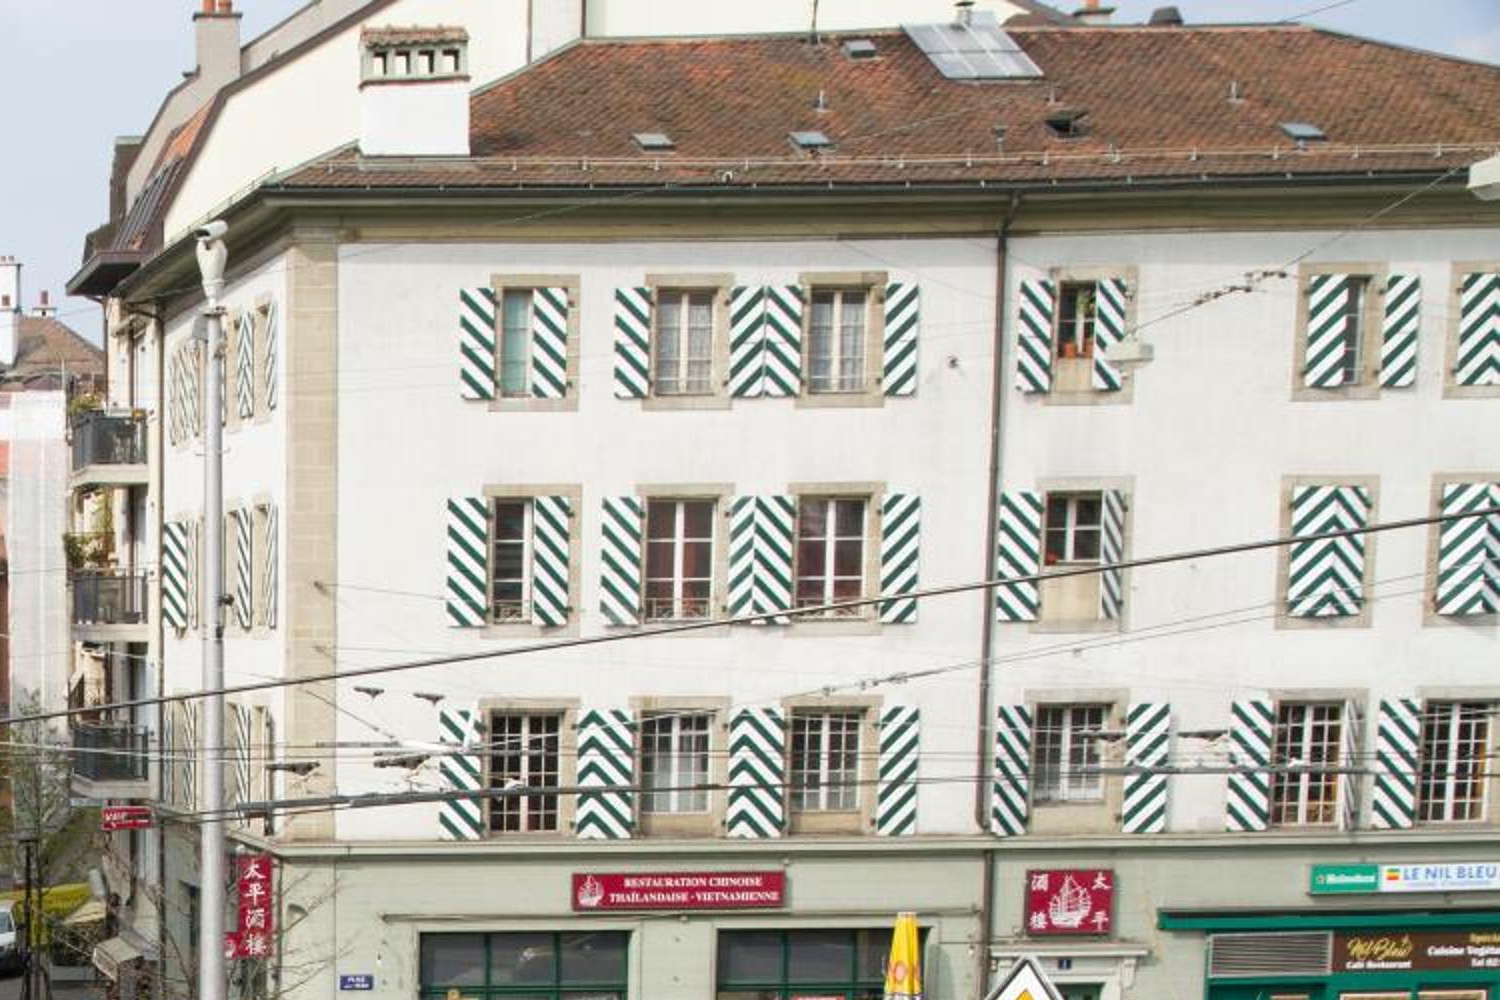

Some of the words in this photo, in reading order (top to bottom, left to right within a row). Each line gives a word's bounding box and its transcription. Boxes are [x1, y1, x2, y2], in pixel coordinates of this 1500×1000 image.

[1403, 868, 1418, 881] LE
[1425, 867, 1452, 880] NIL
[1457, 865, 1498, 880] BLEU
[624, 877, 707, 888] RESTAURATION
[709, 876, 763, 887] CHINOISE
[695, 890, 780, 902] VIETNAMIENNE
